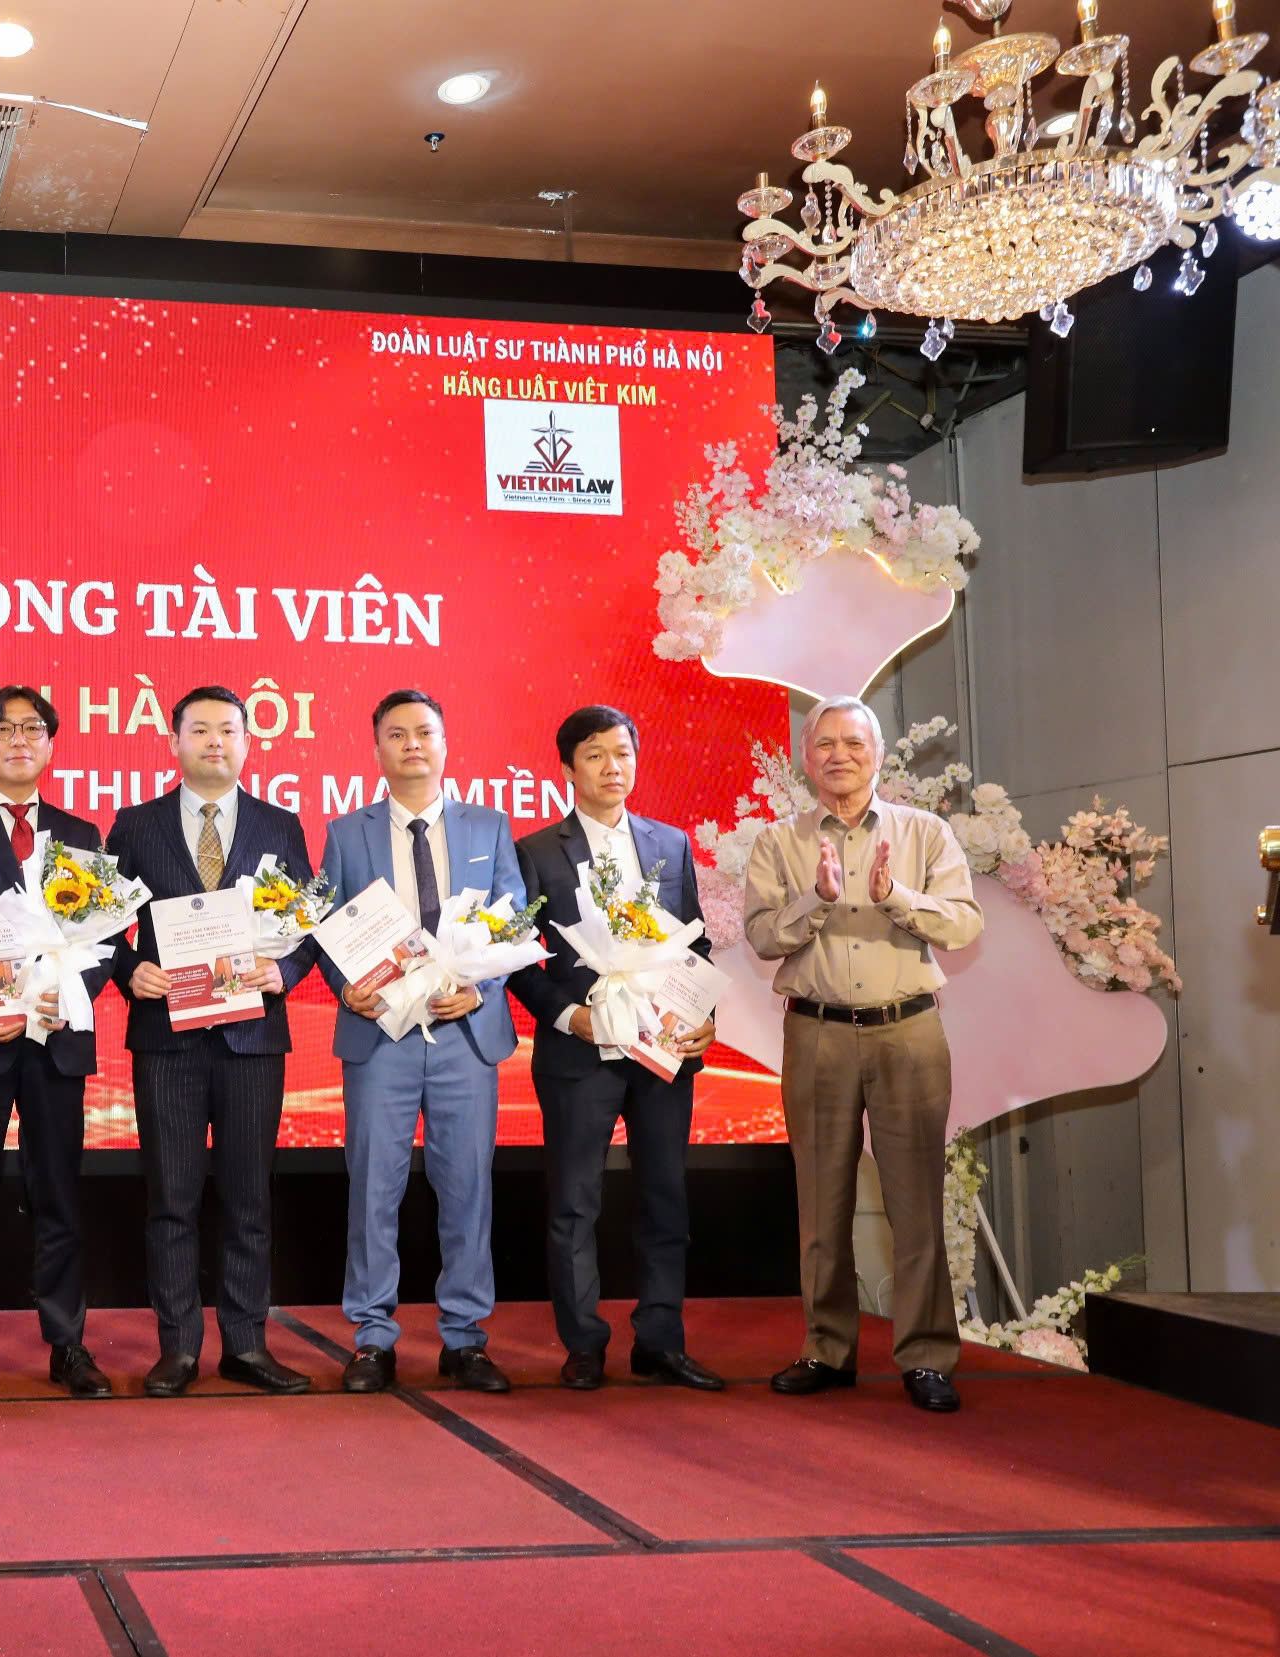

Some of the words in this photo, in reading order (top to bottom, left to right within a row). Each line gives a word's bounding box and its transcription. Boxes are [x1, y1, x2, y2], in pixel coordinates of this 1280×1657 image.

[371, 327, 431, 355] ĐOÀN
[436, 331, 489, 363] LUẬT
[494, 338, 525, 360] SƯ
[530, 336, 600, 365] THÀNH
[606, 339, 647, 367] PHỐ
[653, 343, 681, 369] HÀ
[686, 344, 722, 376] NỘI
[443, 370, 502, 398] HÃNG
[616, 384, 657, 406] KIM
[136, 563, 258, 640] TÀI
[271, 573, 443, 646] VIÊN
[80, 674, 169, 736] HÀ
